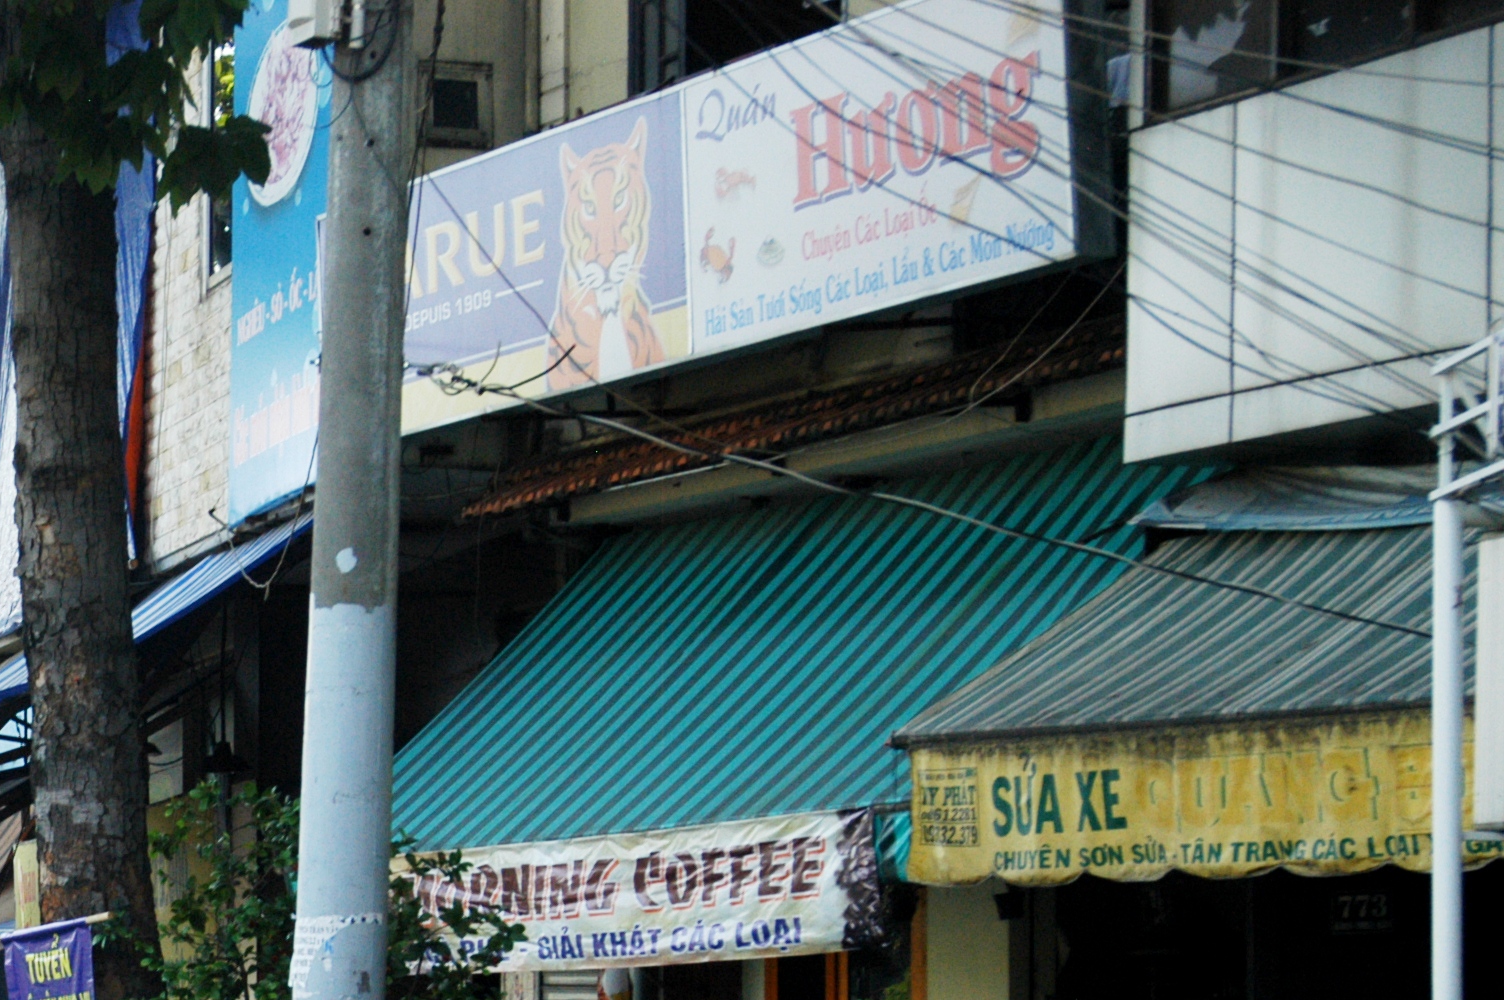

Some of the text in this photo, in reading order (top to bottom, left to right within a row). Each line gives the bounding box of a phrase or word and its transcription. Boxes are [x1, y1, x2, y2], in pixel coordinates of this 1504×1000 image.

[696, 83, 776, 142] Quán
[789, 49, 1042, 212] Hương
[802, 225, 852, 264] Chuyên
[855, 213, 881, 244] Các
[454, 288, 493, 316] 1909
[704, 297, 727, 338] Hải
[729, 292, 755, 330] Sản
[788, 275, 822, 315] Sống
[826, 271, 851, 302] Các
[923, 251, 935, 277] &
[939, 239, 966, 271] Các
[992, 749, 1065, 838] SỬA
[1077, 767, 1128, 832] XE
[633, 836, 827, 913] COFFEE
[995, 843, 1072, 871] CHUYÊN
[1079, 841, 1126, 868] SƠN
[1132, 834, 1169, 866] SỬA
[1179, 836, 1224, 864] TÂN
[1230, 839, 1308, 864] TRANG
[1312, 831, 1357, 861] CÁC
[1337, 893, 1388, 919] 773
[537, 926, 585, 961] GIẢI
[592, 923, 660, 958] KHÁT
[670, 920, 725, 954] CÁC
[735, 916, 802, 952] LOẠI
